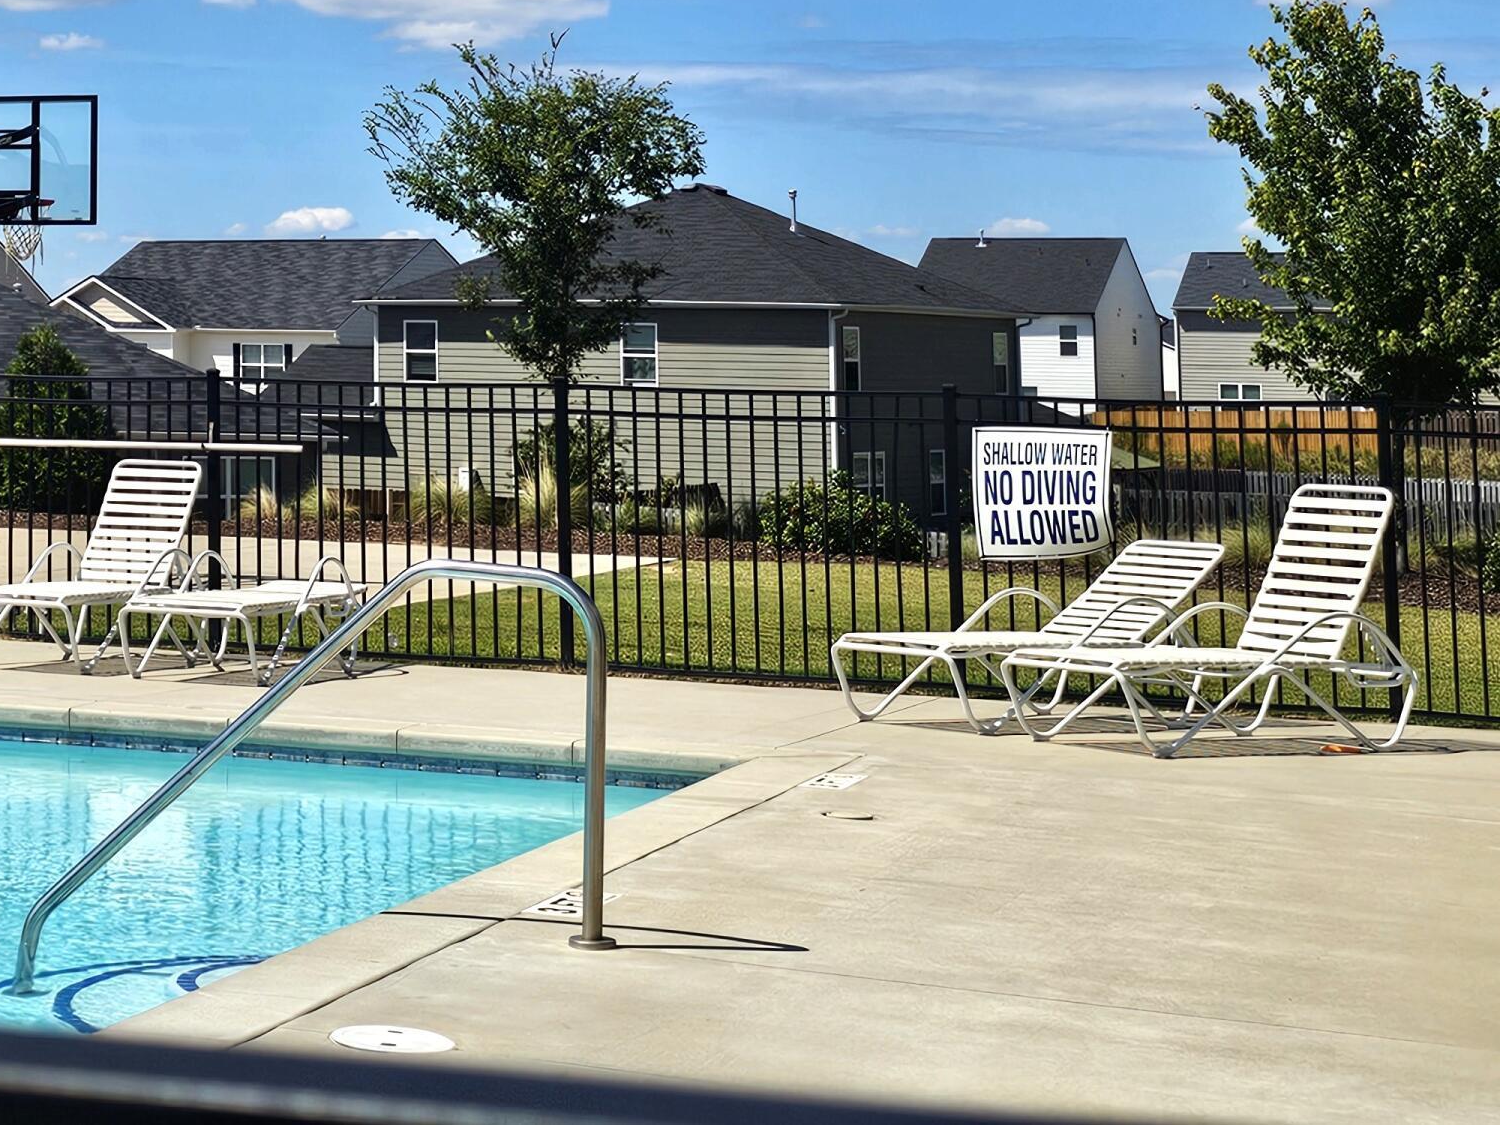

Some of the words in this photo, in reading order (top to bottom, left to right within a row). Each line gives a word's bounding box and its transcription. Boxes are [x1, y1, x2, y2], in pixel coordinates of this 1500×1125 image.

[983, 442, 1047, 466] SHALLOW
[1052, 443, 1098, 466] WATER
[984, 470, 1013, 506] NO
[1021, 470, 1096, 506] DIVING
[991, 510, 1099, 545] ALLOWED
